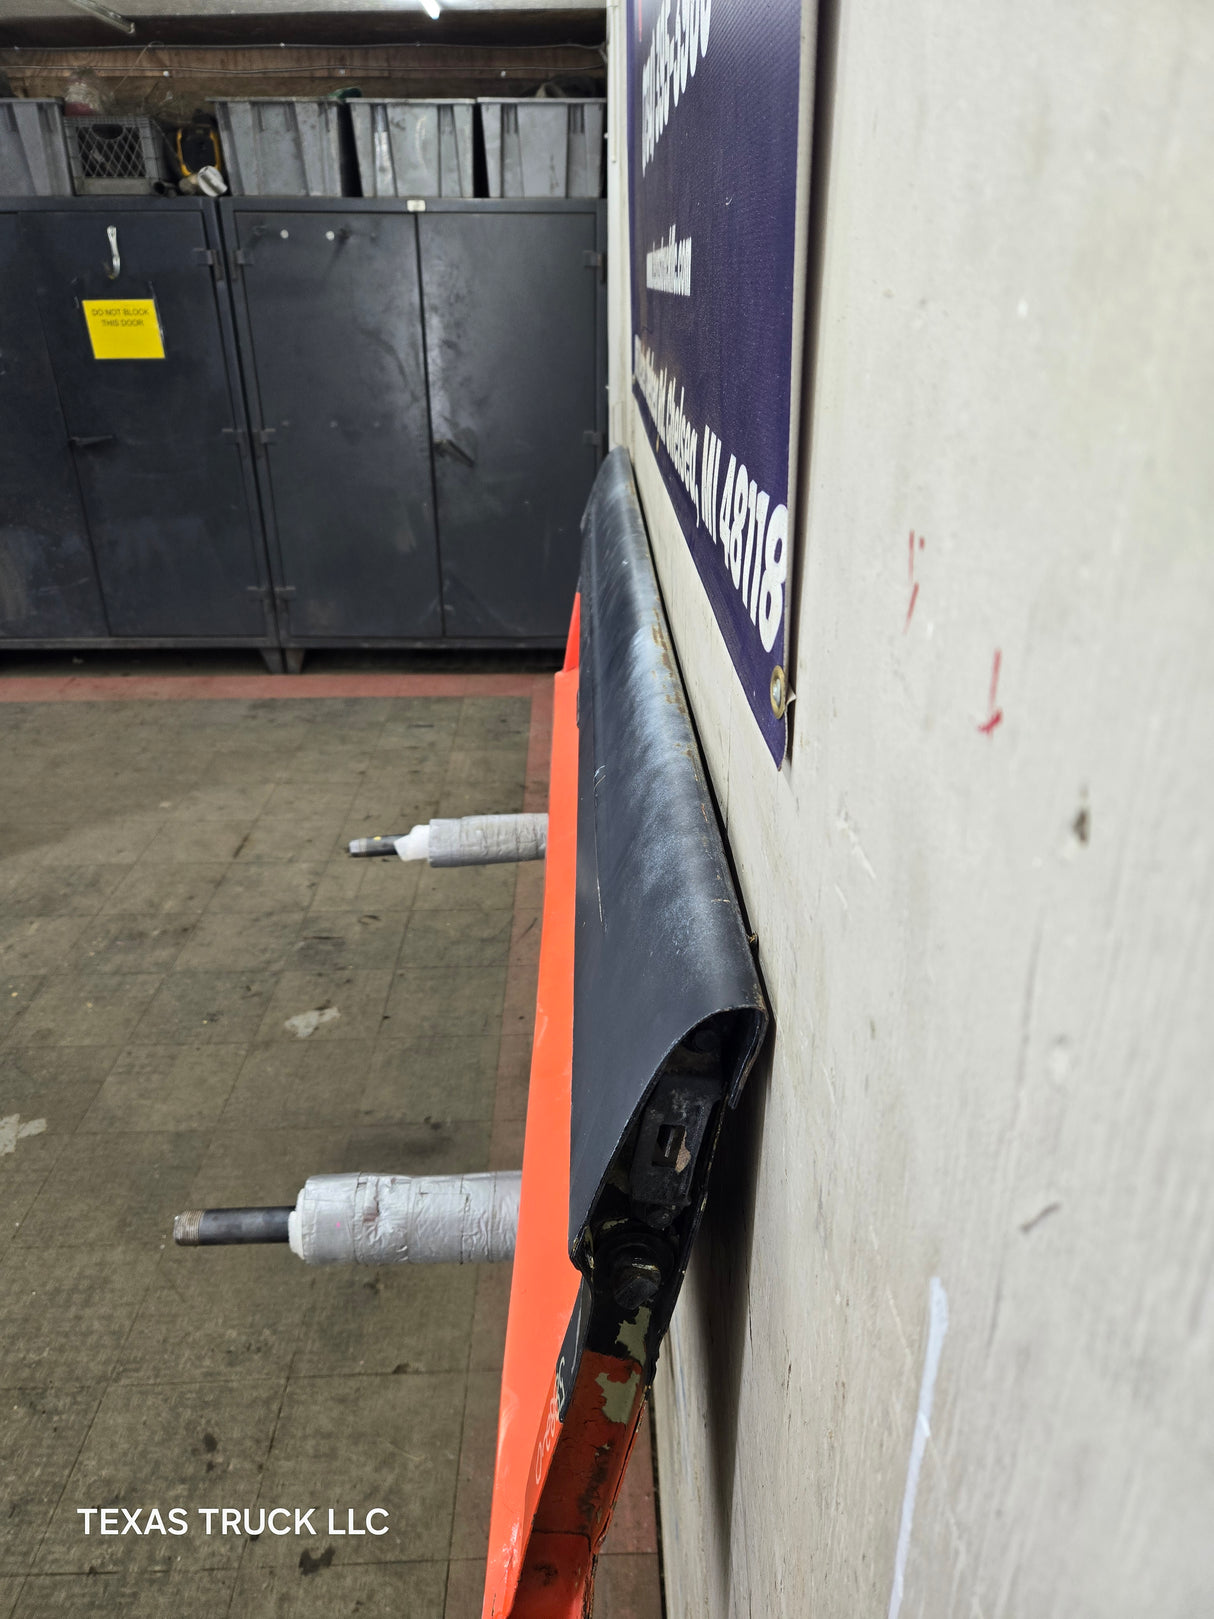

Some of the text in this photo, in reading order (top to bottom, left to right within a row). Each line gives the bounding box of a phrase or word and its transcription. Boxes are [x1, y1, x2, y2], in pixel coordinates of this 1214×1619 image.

[92, 308, 149, 316] DO NOT BLOCK
[101, 319, 144, 327] THIS DOOR
[666, 376, 699, 528] Chelsea,
[701, 423, 722, 545] MI
[719, 453, 788, 653] 48118
